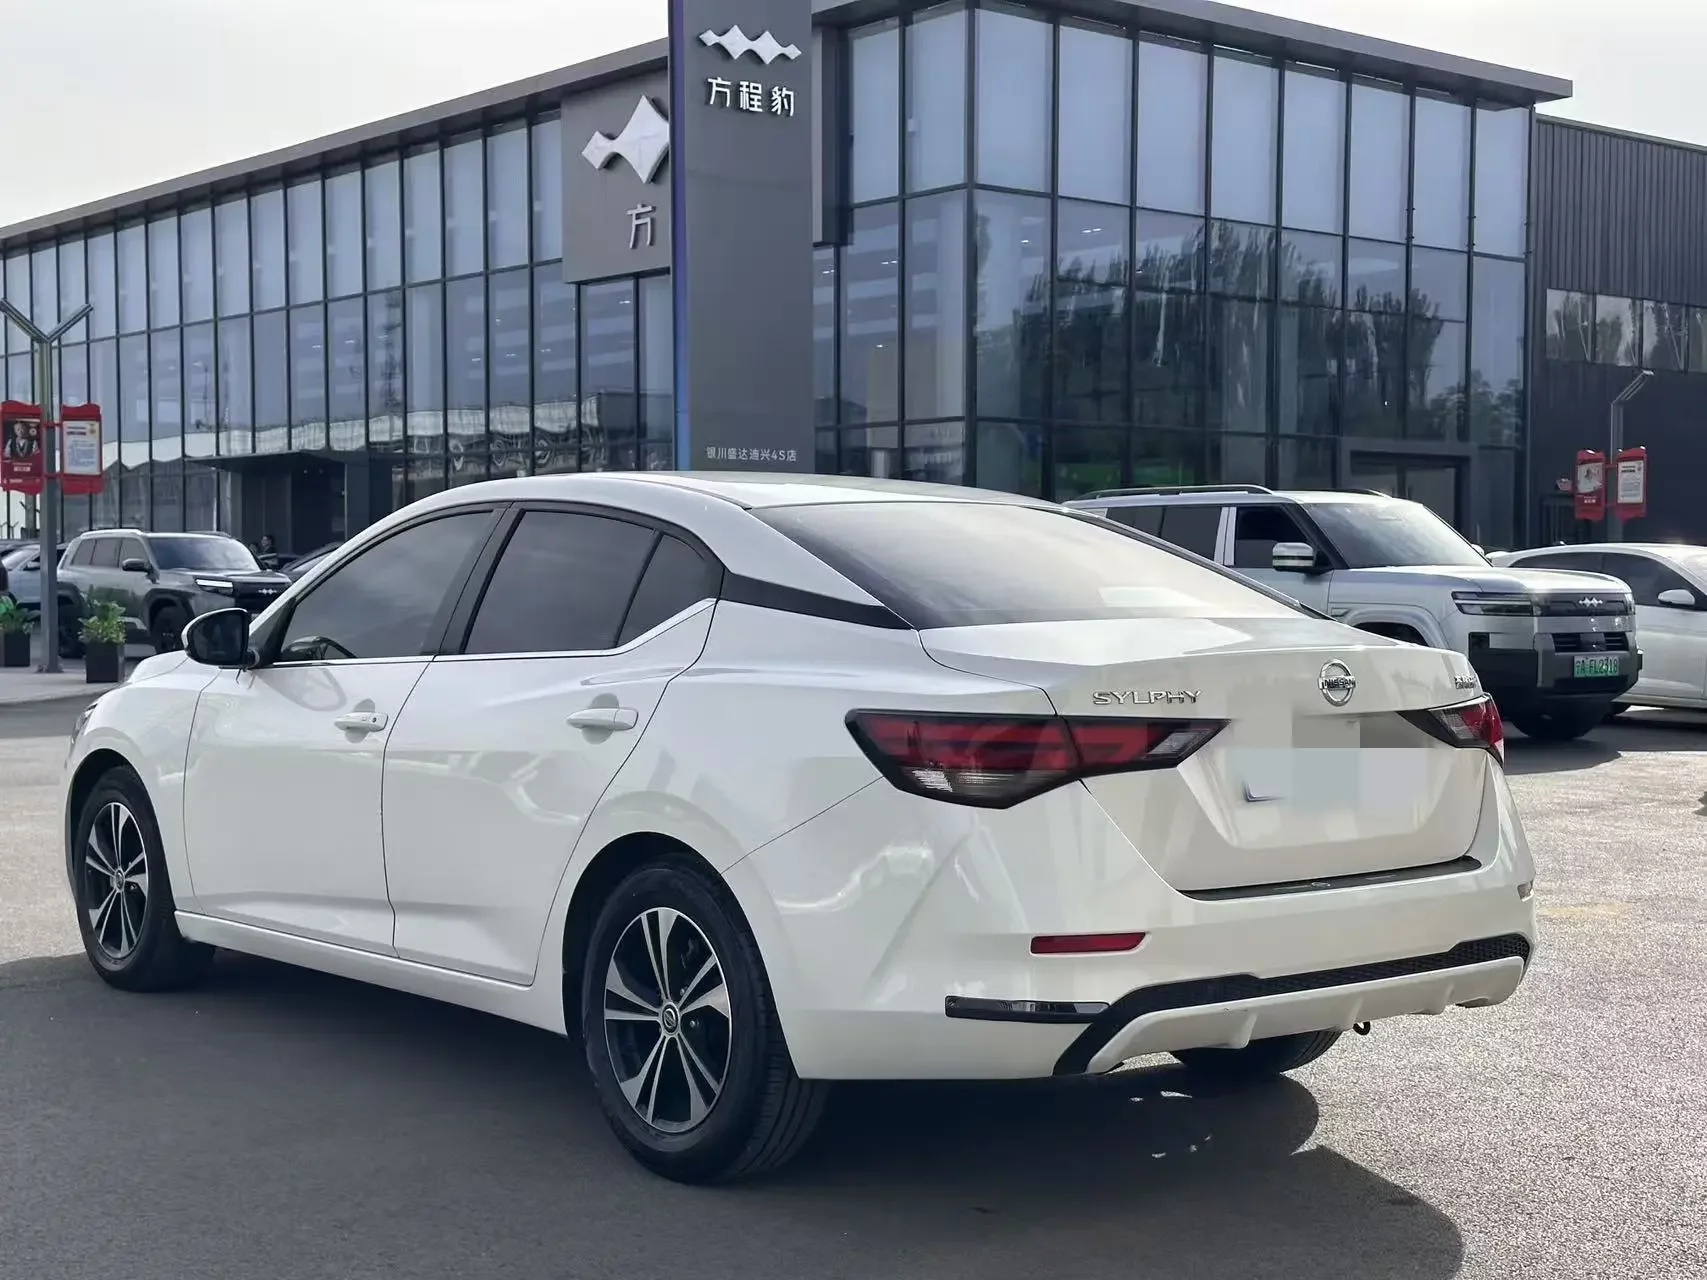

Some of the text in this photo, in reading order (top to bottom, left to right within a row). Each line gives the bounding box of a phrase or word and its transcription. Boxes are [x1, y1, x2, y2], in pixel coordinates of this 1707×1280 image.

[707, 76, 795, 117] 方程豹
[627, 203, 655, 249] 方
[1092, 690, 1201, 705] SYLPHY
[1322, 678, 1355, 689] NISSAN
